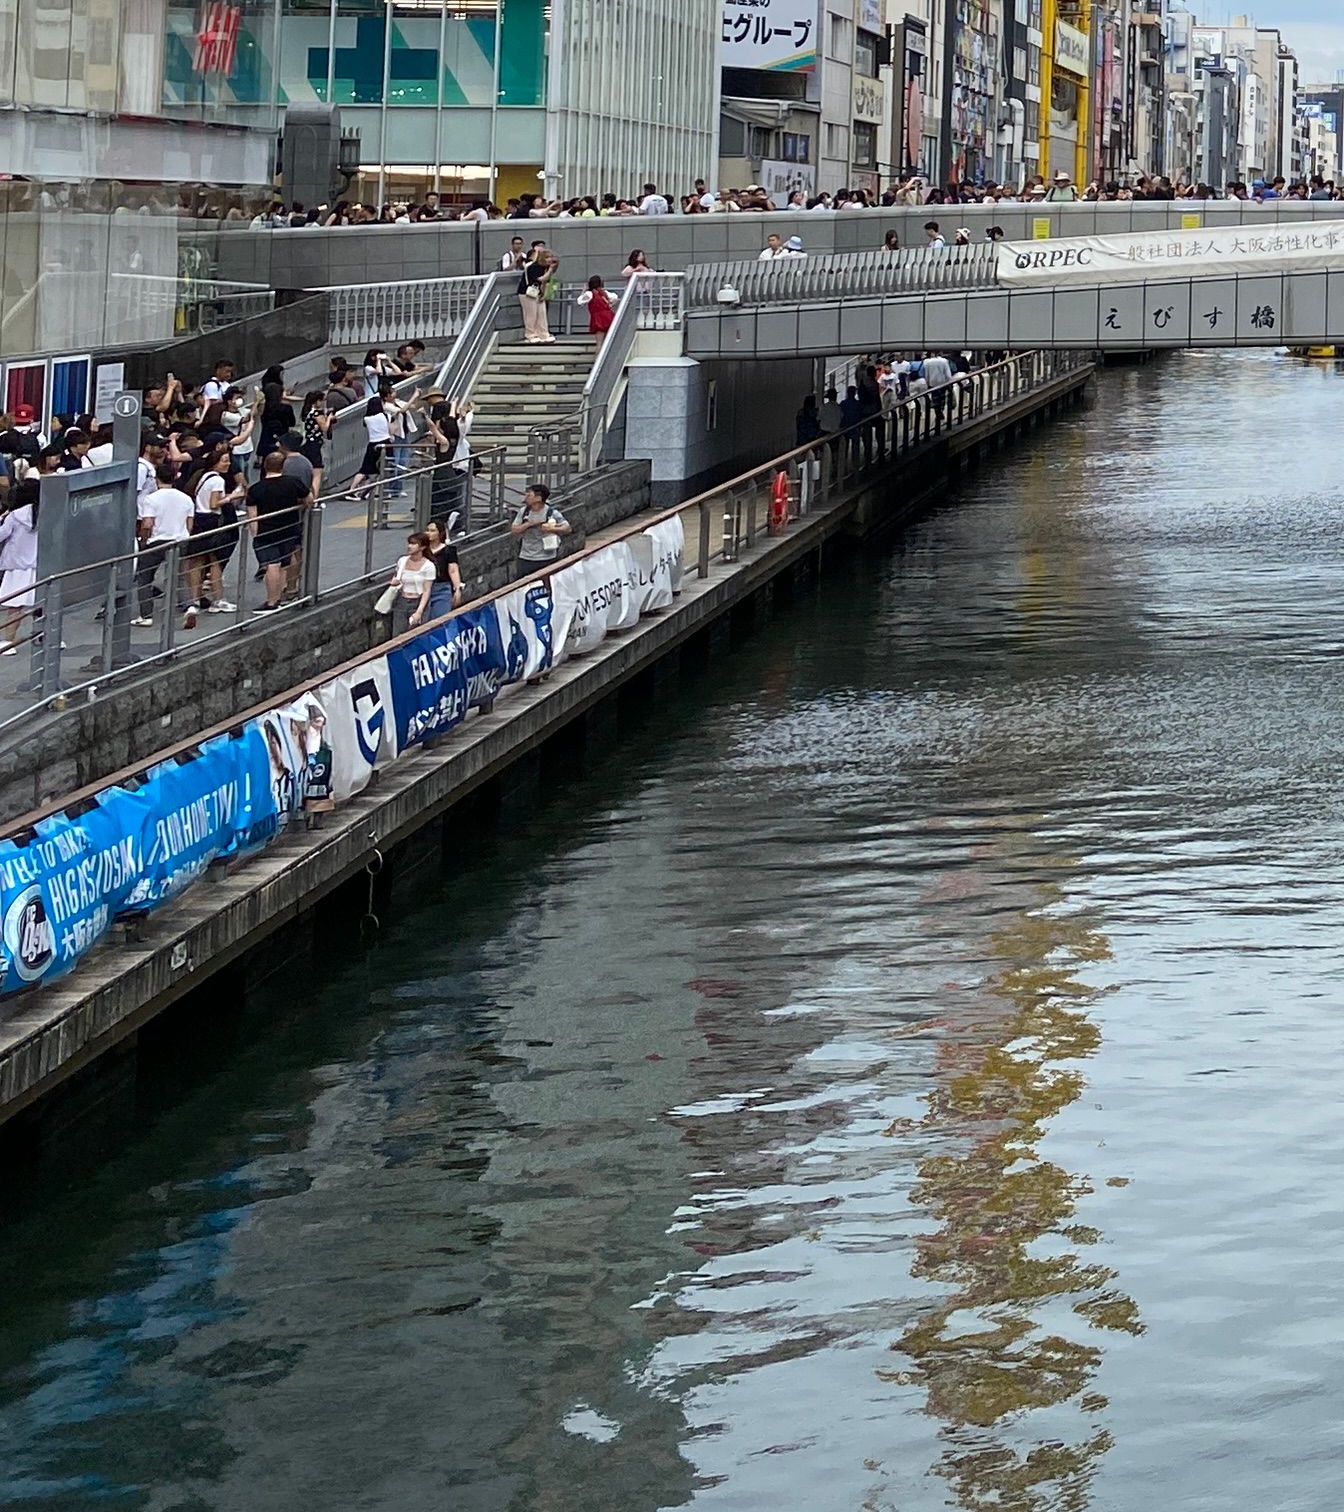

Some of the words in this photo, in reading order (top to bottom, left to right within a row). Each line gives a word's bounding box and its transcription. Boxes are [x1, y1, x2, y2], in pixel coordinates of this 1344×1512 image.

[1109, 239, 1220, 263] 一般社団法人
[1104, 304, 1275, 331] えびす橋
